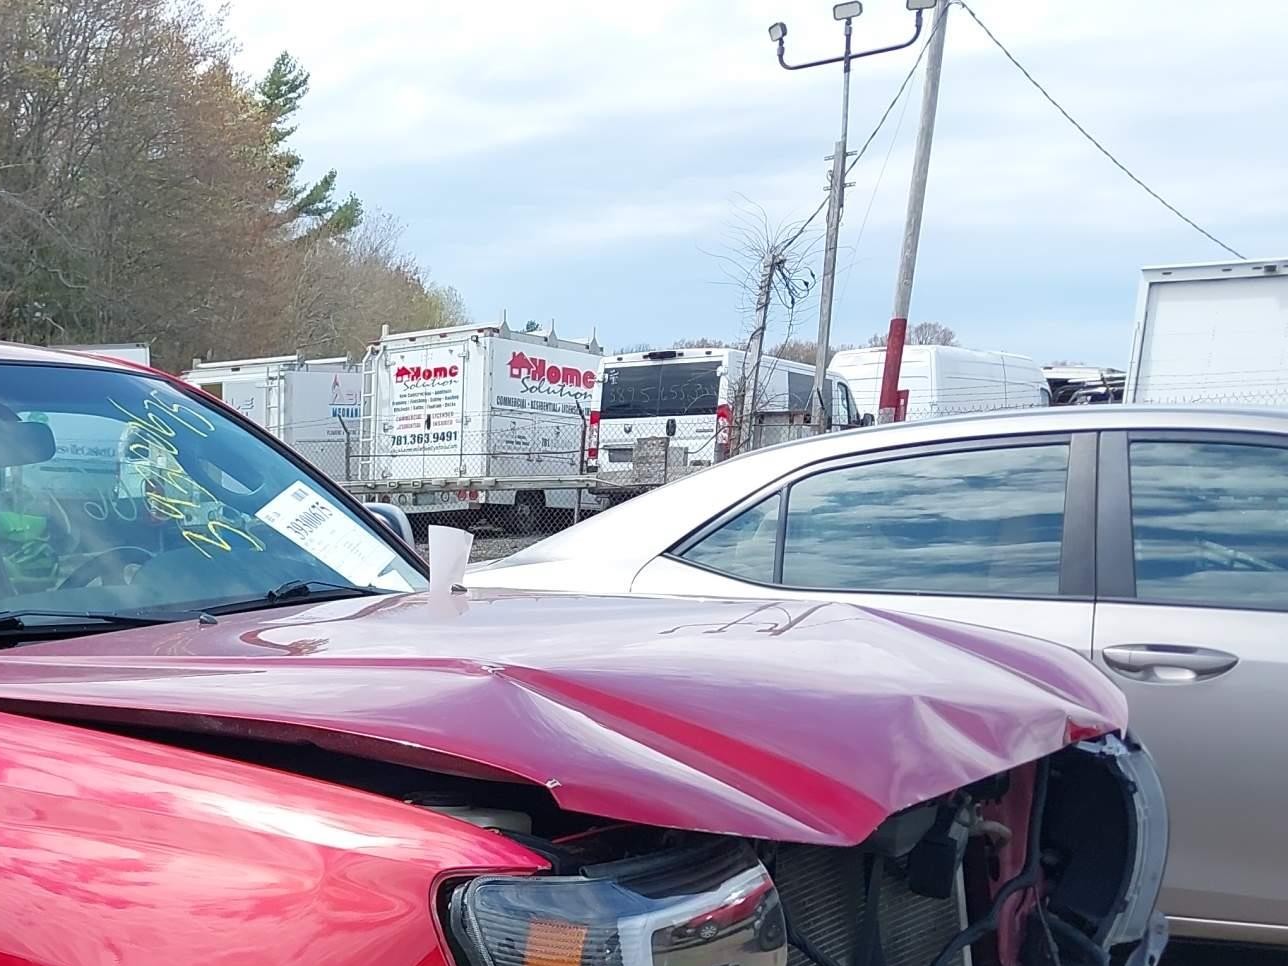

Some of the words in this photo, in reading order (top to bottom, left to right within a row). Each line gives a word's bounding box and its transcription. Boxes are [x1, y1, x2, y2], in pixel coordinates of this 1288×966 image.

[403, 377, 459, 392] Solution
[529, 357, 596, 389] Home
[520, 376, 593, 400] Solution
[391, 430, 458, 447] 781.363.9491
[285, 501, 334, 541] 39300675
